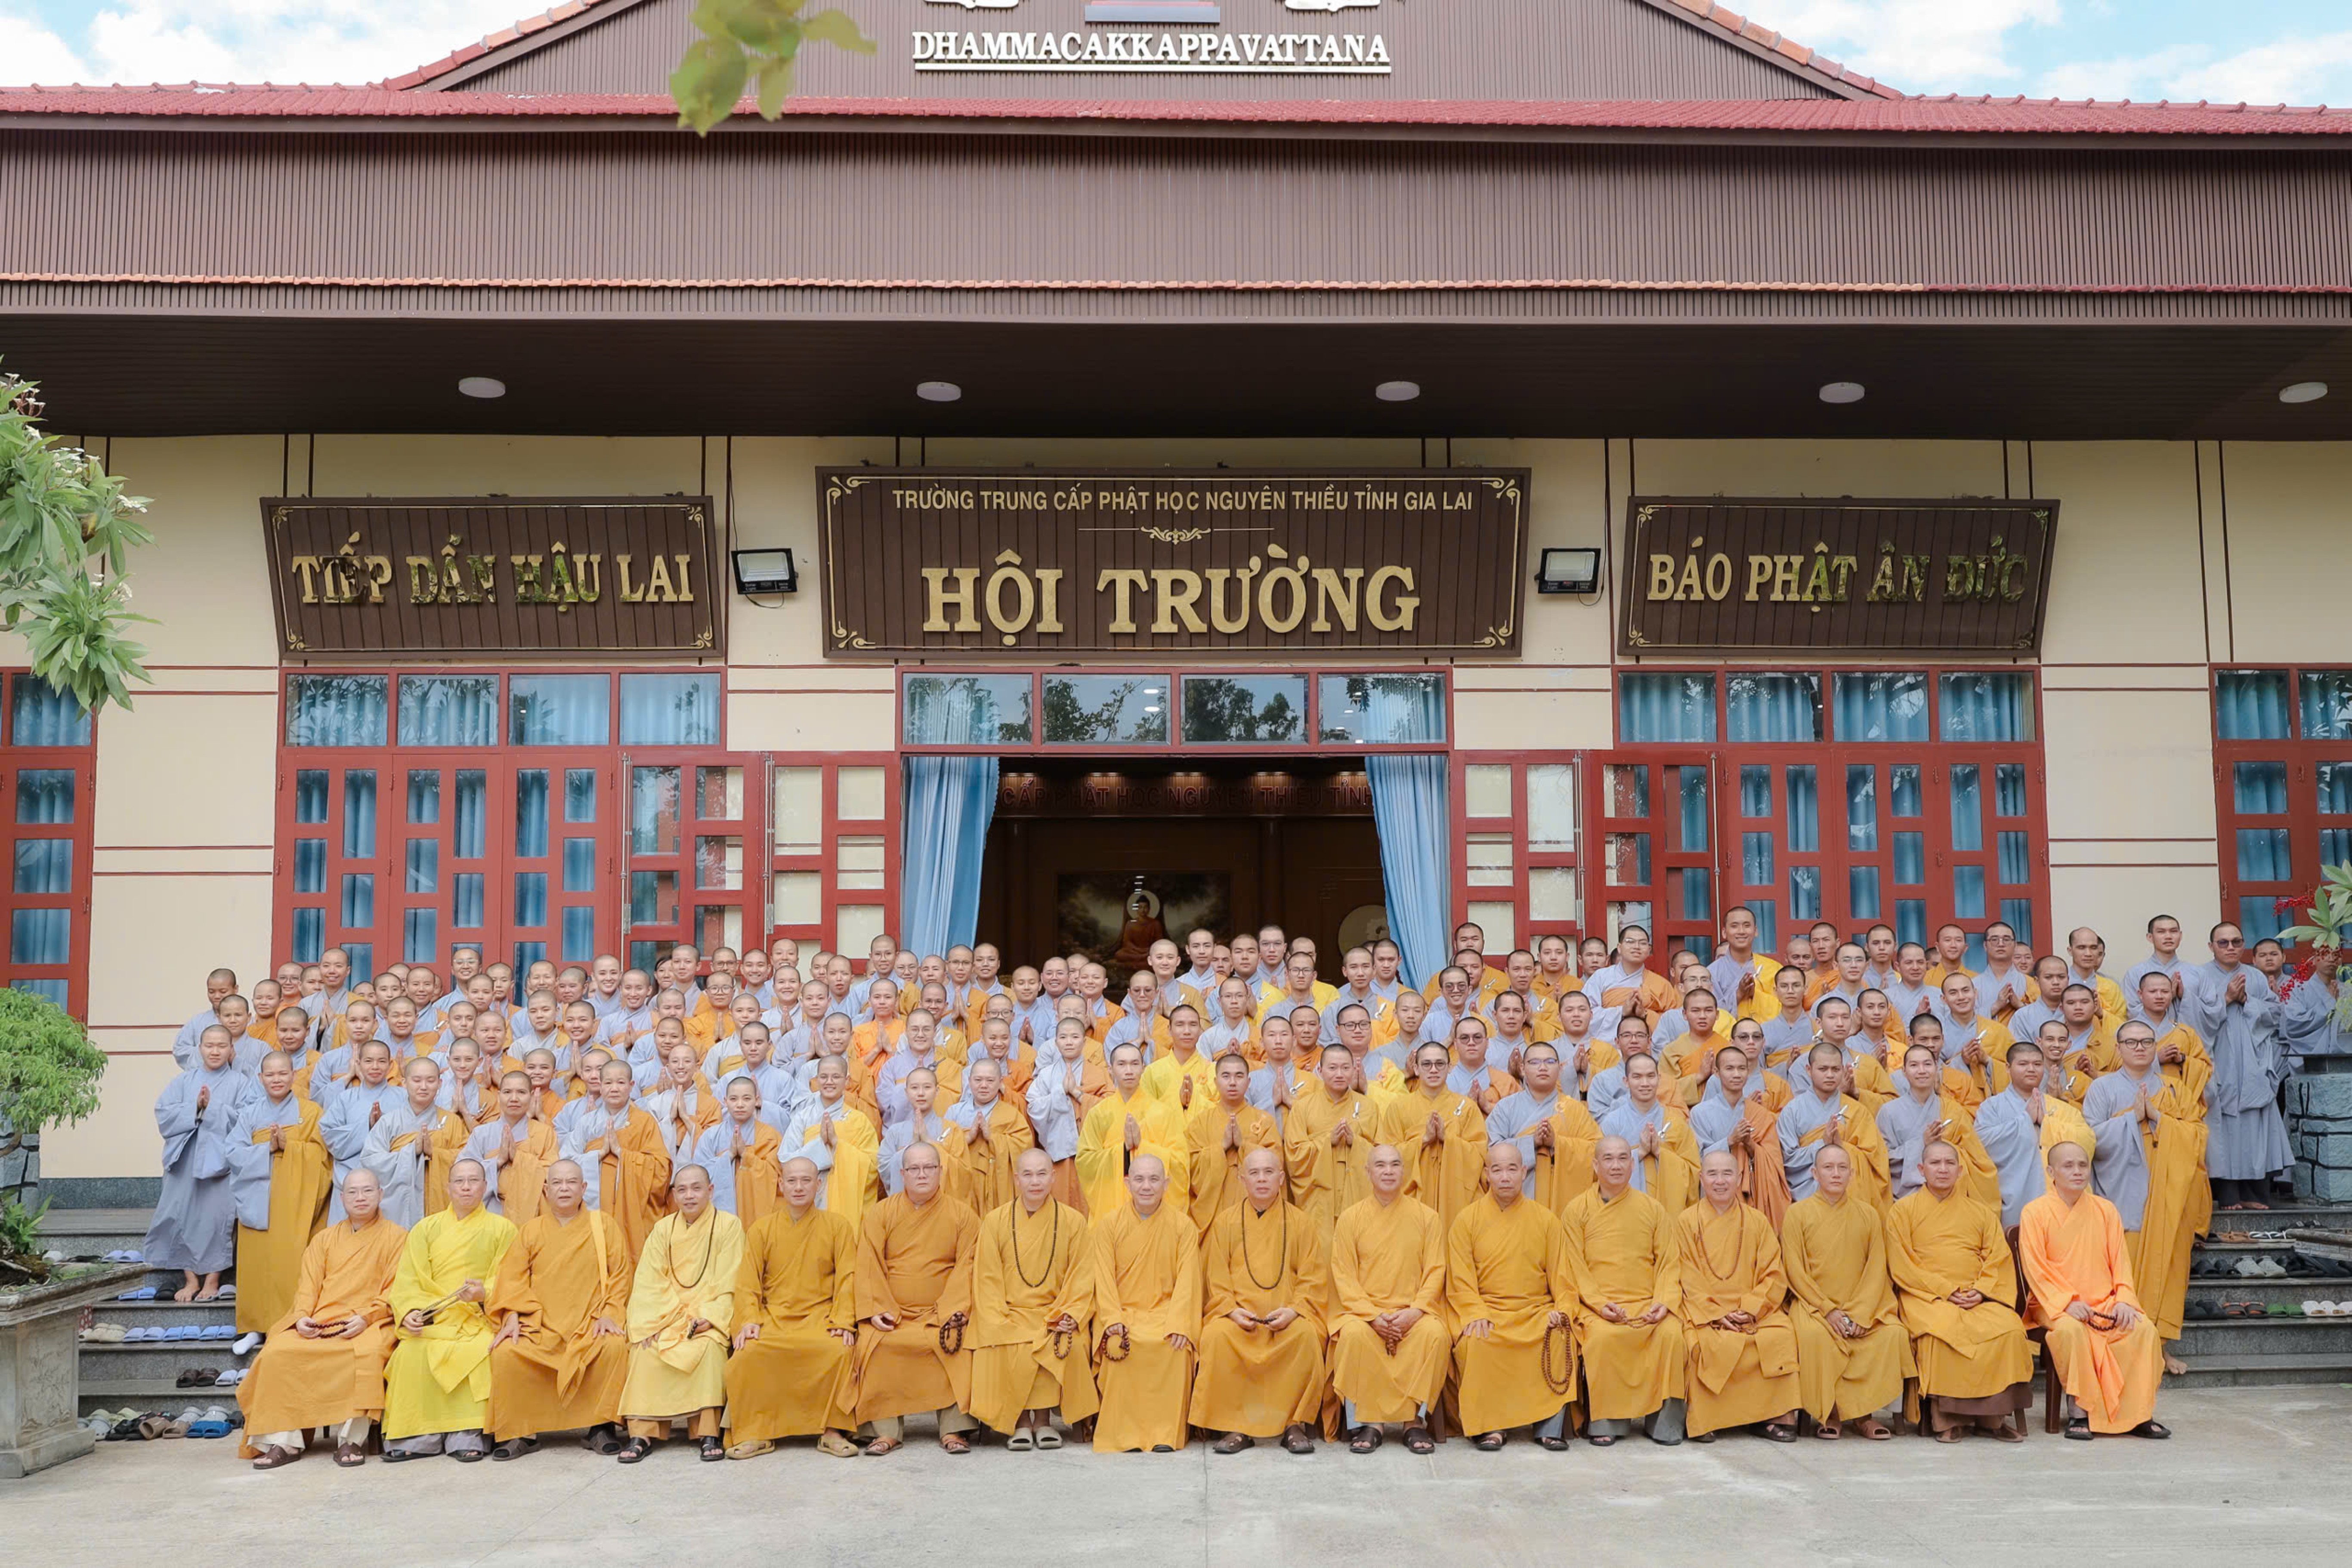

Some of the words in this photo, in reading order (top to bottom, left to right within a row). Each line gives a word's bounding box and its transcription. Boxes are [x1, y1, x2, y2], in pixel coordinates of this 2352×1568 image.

[912, 31, 1390, 63] DHAMMACAKKAPPAVATTANA
[892, 483, 974, 510] TRƯỜNG
[980, 491, 1047, 510] TRUNG
[1053, 482, 1093, 511] CẤP
[1099, 486, 1150, 514] PHẬT
[1156, 491, 1199, 514] HỌC
[1205, 485, 1286, 510] NGUYÊN
[1354, 483, 1397, 510] TỈNH
[1404, 491, 1436, 510] GIA
[1443, 492, 1472, 510] LAI
[291, 531, 393, 603] TIẾP
[510, 541, 602, 612] HẬU
[616, 554, 694, 603] LAI
[921, 548, 1064, 646] HỘI
[1096, 543, 1420, 634] TRƯỜNG
[1647, 536, 1733, 601] BÁO
[1744, 541, 1858, 613] PHẬT
[1866, 541, 1930, 602] ÂN
